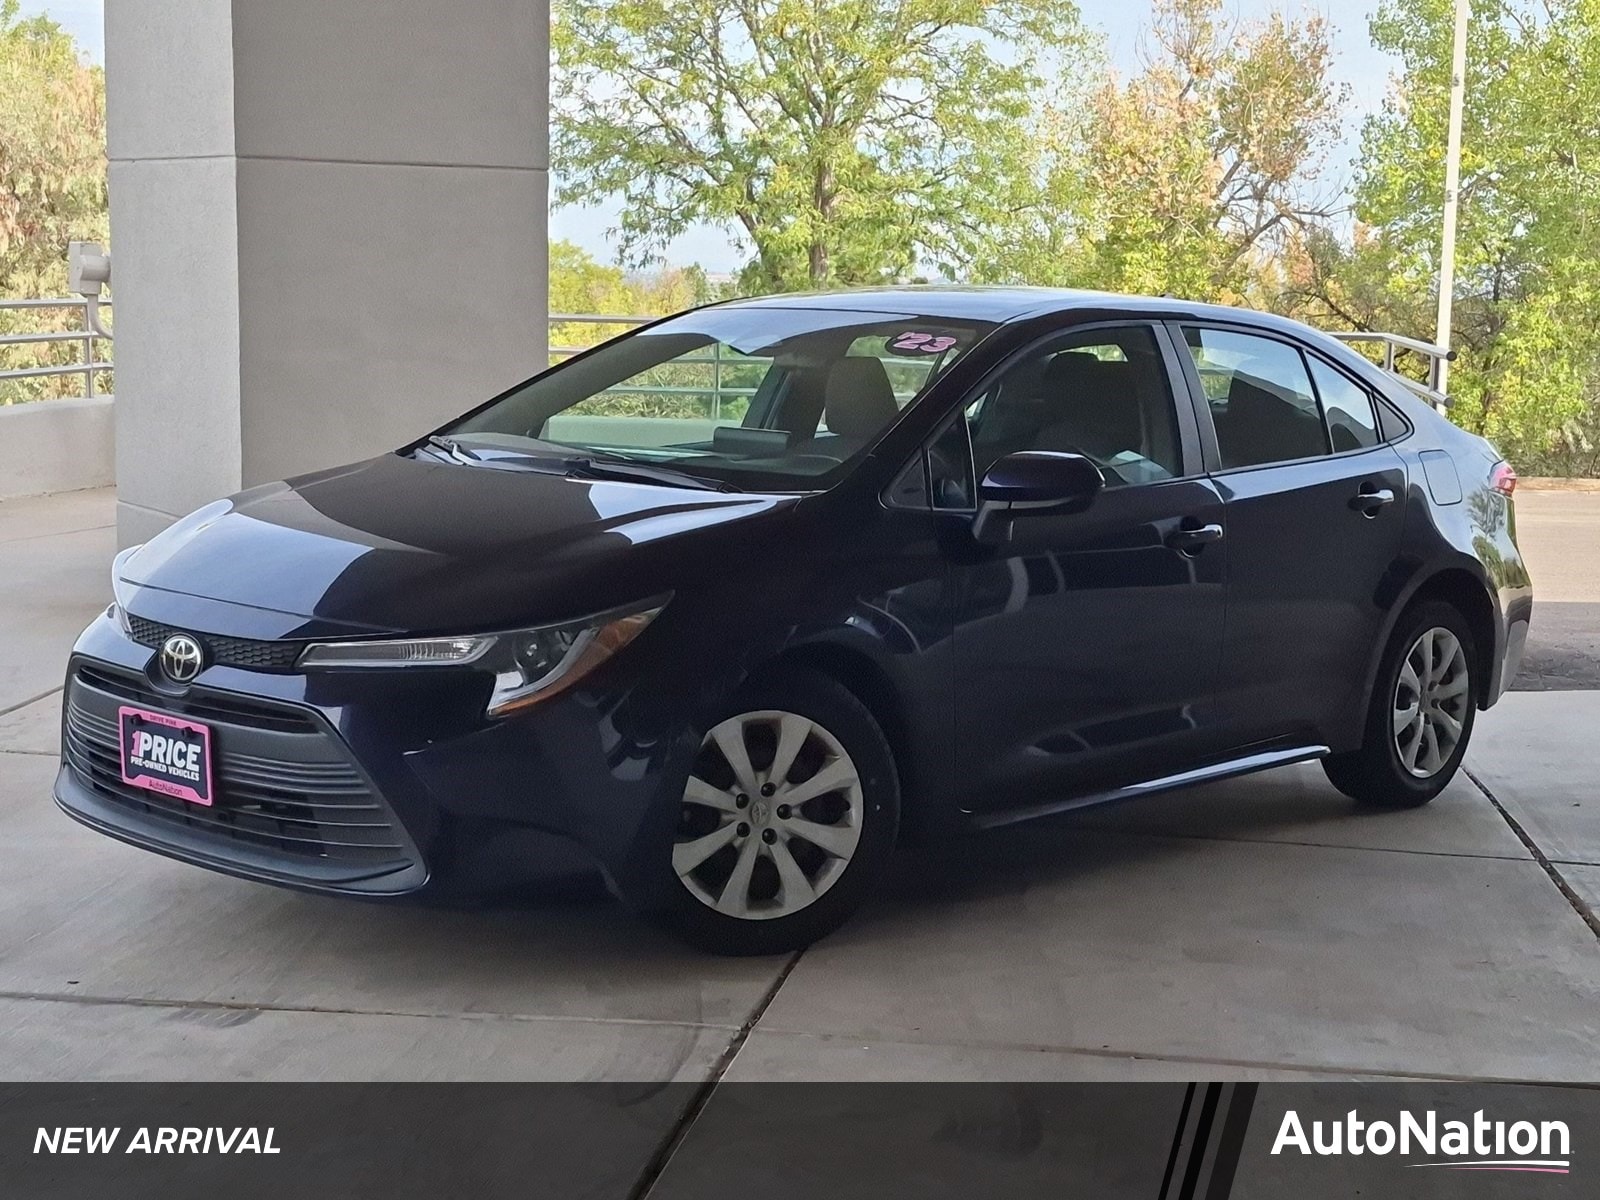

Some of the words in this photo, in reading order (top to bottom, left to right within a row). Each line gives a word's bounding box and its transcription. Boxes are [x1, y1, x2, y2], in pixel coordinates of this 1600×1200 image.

[130, 756, 167, 773] PRE-OWNED
[168, 765, 200, 781] VEHICLES
[148, 780, 183, 796] AutoNation
